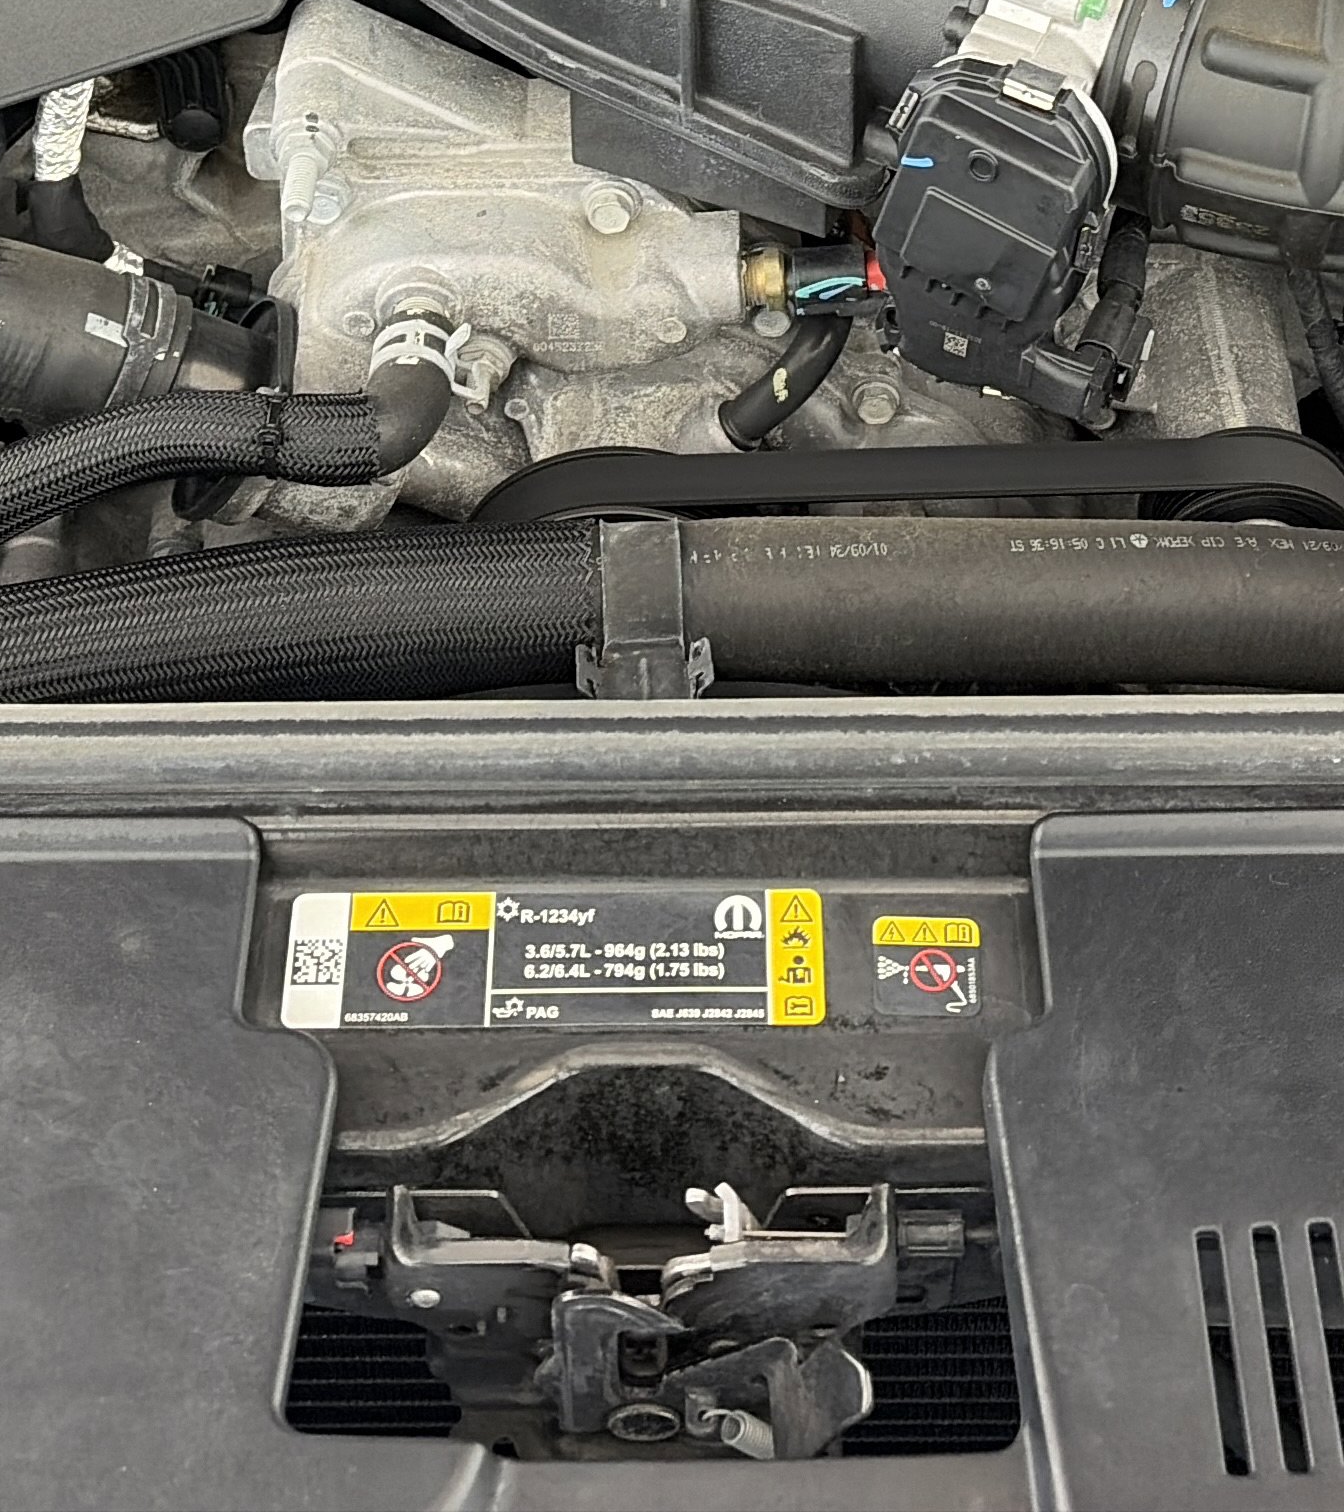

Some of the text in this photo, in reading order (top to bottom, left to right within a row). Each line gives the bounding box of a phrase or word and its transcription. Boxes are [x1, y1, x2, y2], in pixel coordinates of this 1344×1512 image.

[520, 908, 596, 927] R-1234yf
[524, 943, 591, 959] 3.6/5.7L
[604, 943, 646, 961] 964g
[649, 942, 690, 960] (2.13
[693, 942, 725, 960] lbs)
[523, 963, 591, 979] 6.2/6.4L
[604, 963, 646, 981] 794g
[649, 962, 690, 981] (1.75
[693, 962, 725, 980] lbs)
[343, 1011, 409, 1023] 68357420AB
[526, 1006, 560, 1020] PAG
[651, 1008, 675, 1019] SAE
